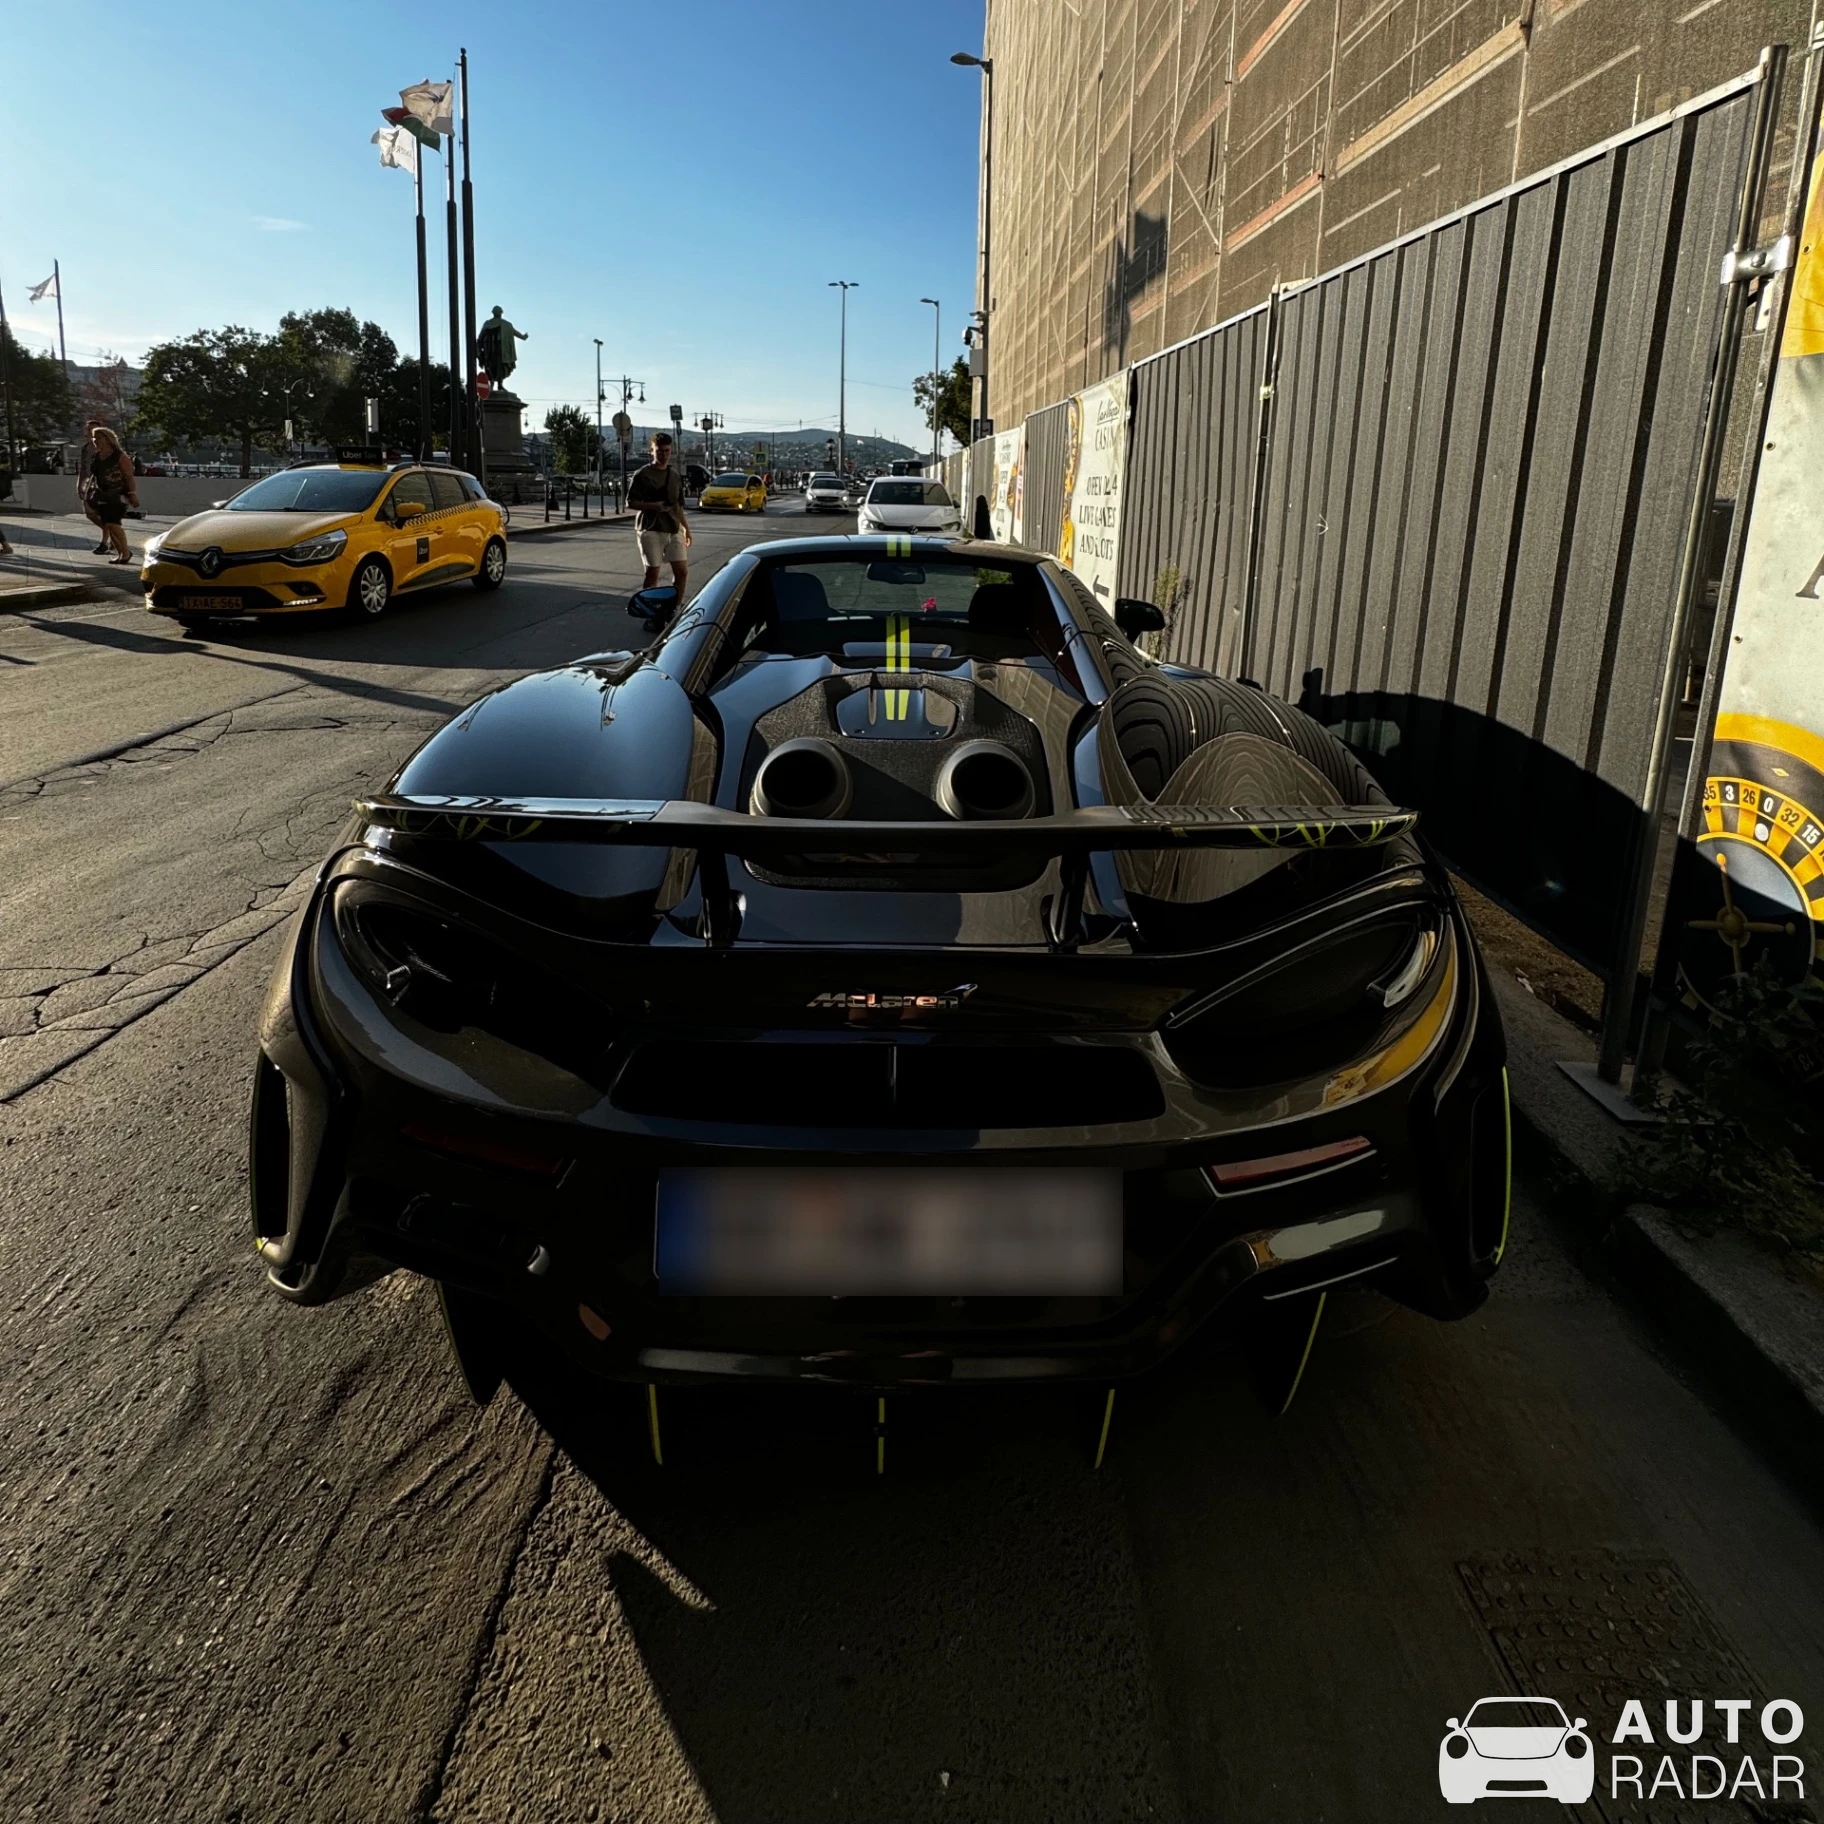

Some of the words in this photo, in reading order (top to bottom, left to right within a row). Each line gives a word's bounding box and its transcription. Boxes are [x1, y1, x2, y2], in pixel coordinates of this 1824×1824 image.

[1095, 426, 1116, 452] CASIN
[342, 450, 362, 459] Uber
[1086, 475, 1102, 496] OPEN
[1079, 533, 1095, 555] AND
[1703, 784, 1717, 801] 35
[1724, 784, 1735, 801] 3
[1742, 788, 1756, 805] 26
[1763, 797, 1774, 813] 0
[1780, 807, 1800, 828] 32
[1801, 823, 1821, 845] 15
[806, 992, 959, 1008] McLaren
